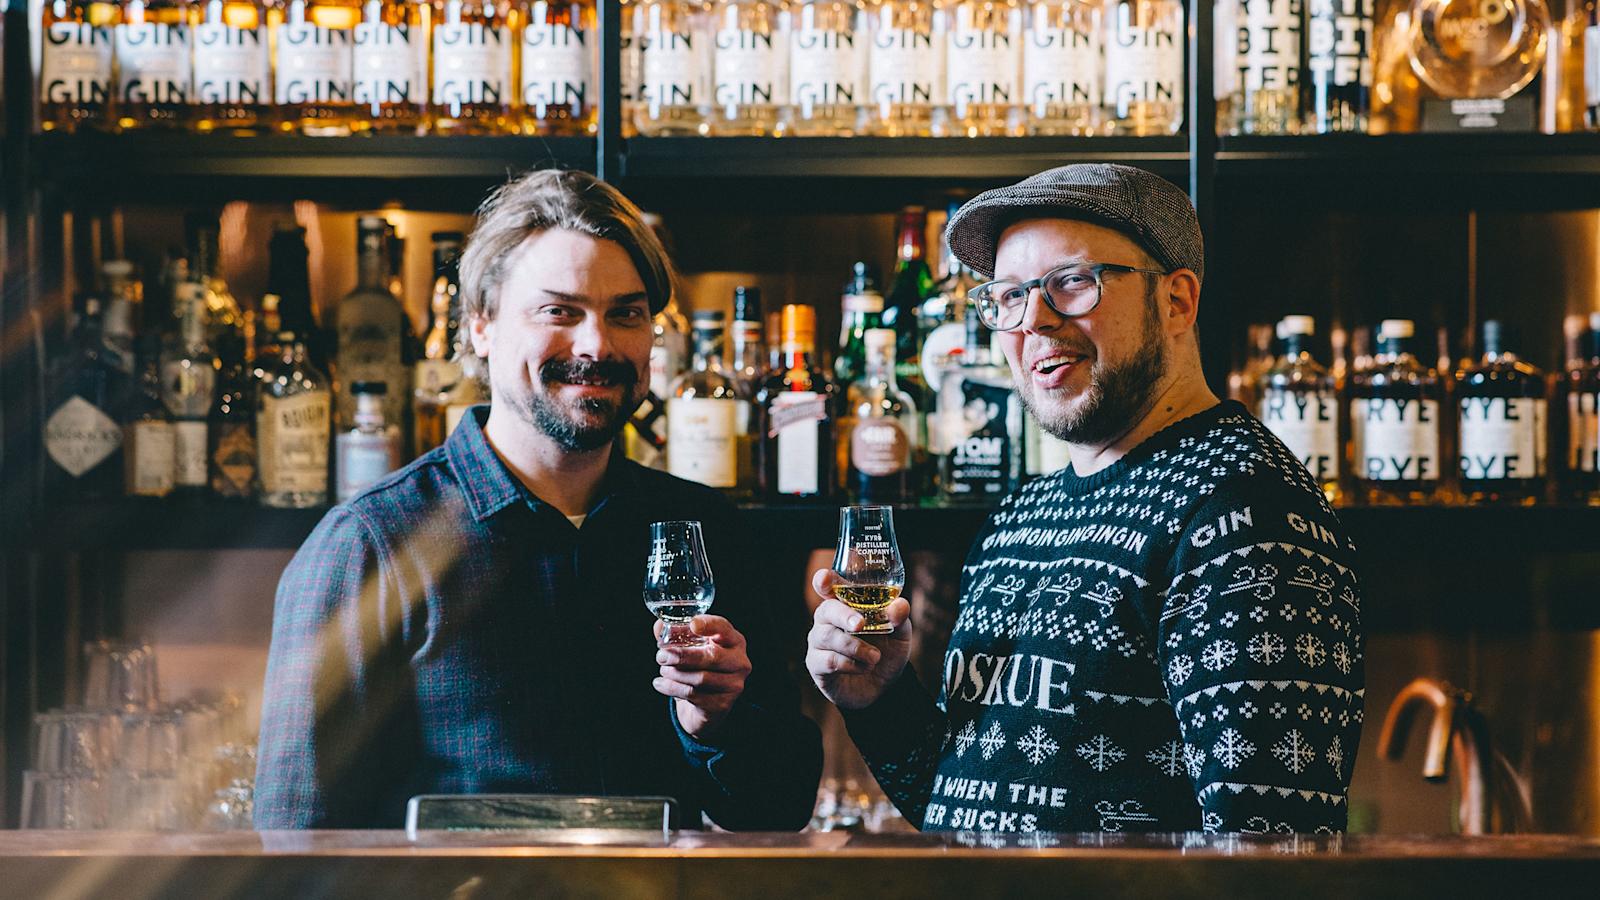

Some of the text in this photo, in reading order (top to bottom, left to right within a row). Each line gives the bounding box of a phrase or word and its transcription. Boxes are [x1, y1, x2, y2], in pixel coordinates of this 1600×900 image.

[48, 25, 110, 45] GIN
[125, 25, 186, 44] GIN
[200, 25, 260, 44] GIN
[287, 26, 350, 44] GIN
[353, 25, 410, 44] GIN
[442, 25, 500, 44] GIN
[525, 25, 585, 45] GIN
[715, 31, 772, 48] GIN
[800, 31, 853, 48] GIN
[875, 30, 931, 48] GIN
[955, 30, 1010, 48] GIN
[1034, 30, 1089, 48] GIN
[1117, 30, 1173, 47] GIN
[49, 80, 110, 101] GIN
[125, 80, 187, 101] GIN
[200, 80, 260, 101] GIN
[287, 80, 350, 101] GIN
[353, 80, 410, 101] GIN
[442, 80, 500, 101] GIN
[525, 81, 585, 101] GIN
[715, 83, 772, 102] GIN
[800, 83, 853, 102] GIN
[875, 82, 931, 101] GIN
[954, 82, 1009, 101] GIN
[1034, 82, 1089, 101] GIN
[1117, 81, 1172, 101] GIN
[1269, 395, 1329, 421] RYE
[1368, 397, 1430, 421] RYE
[1461, 398, 1519, 421] RYE
[1367, 457, 1430, 480] RYE
[1461, 456, 1519, 478] RYE
[865, 533, 882, 541] KYRÖ
[1190, 506, 1253, 548] GIN
[1287, 512, 1338, 549] GIN
[936, 648, 1076, 715] OSKUE
[943, 776, 998, 801] WHEN
[1009, 783, 1067, 808] THE
[950, 807, 1038, 833] SUCKS
